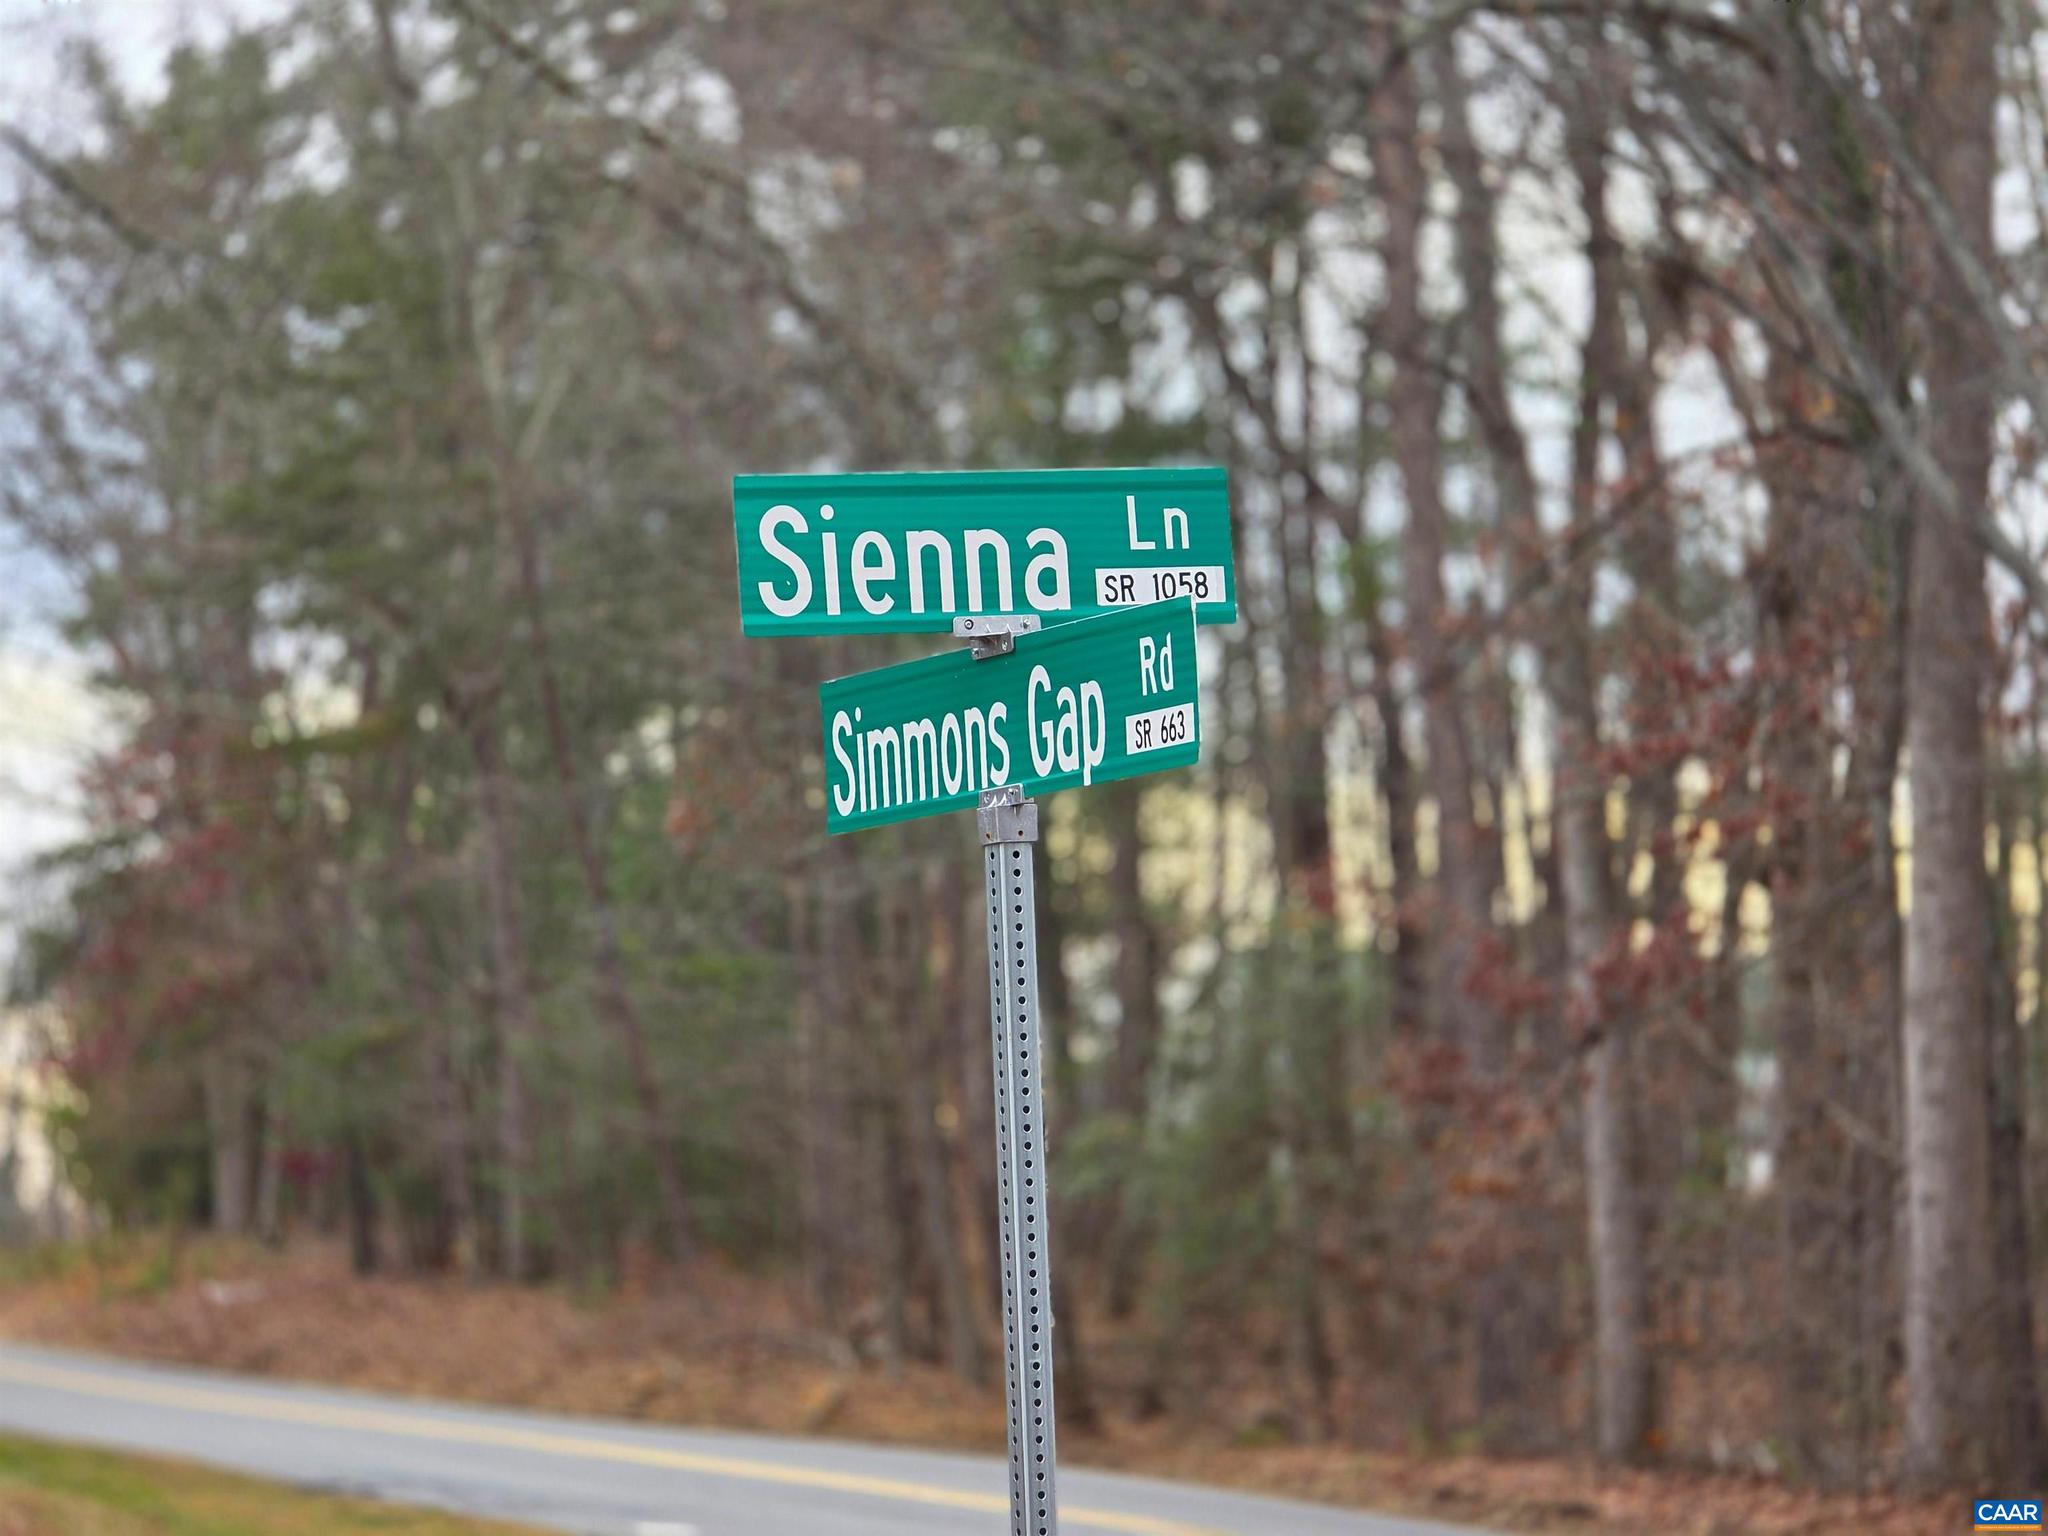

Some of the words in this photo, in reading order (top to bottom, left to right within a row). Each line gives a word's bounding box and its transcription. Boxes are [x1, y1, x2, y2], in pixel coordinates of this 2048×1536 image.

[758, 504, 1071, 617] Sienna
[1126, 495, 1190, 551] Ln
[1104, 575, 1136, 603] SR
[1152, 571, 1209, 601] 1058
[832, 701, 1011, 817] Simmons
[1027, 664, 1106, 786] Gap
[1139, 632, 1174, 697] Rd
[1135, 719, 1153, 749] SR
[1160, 711, 1186, 744] 663
